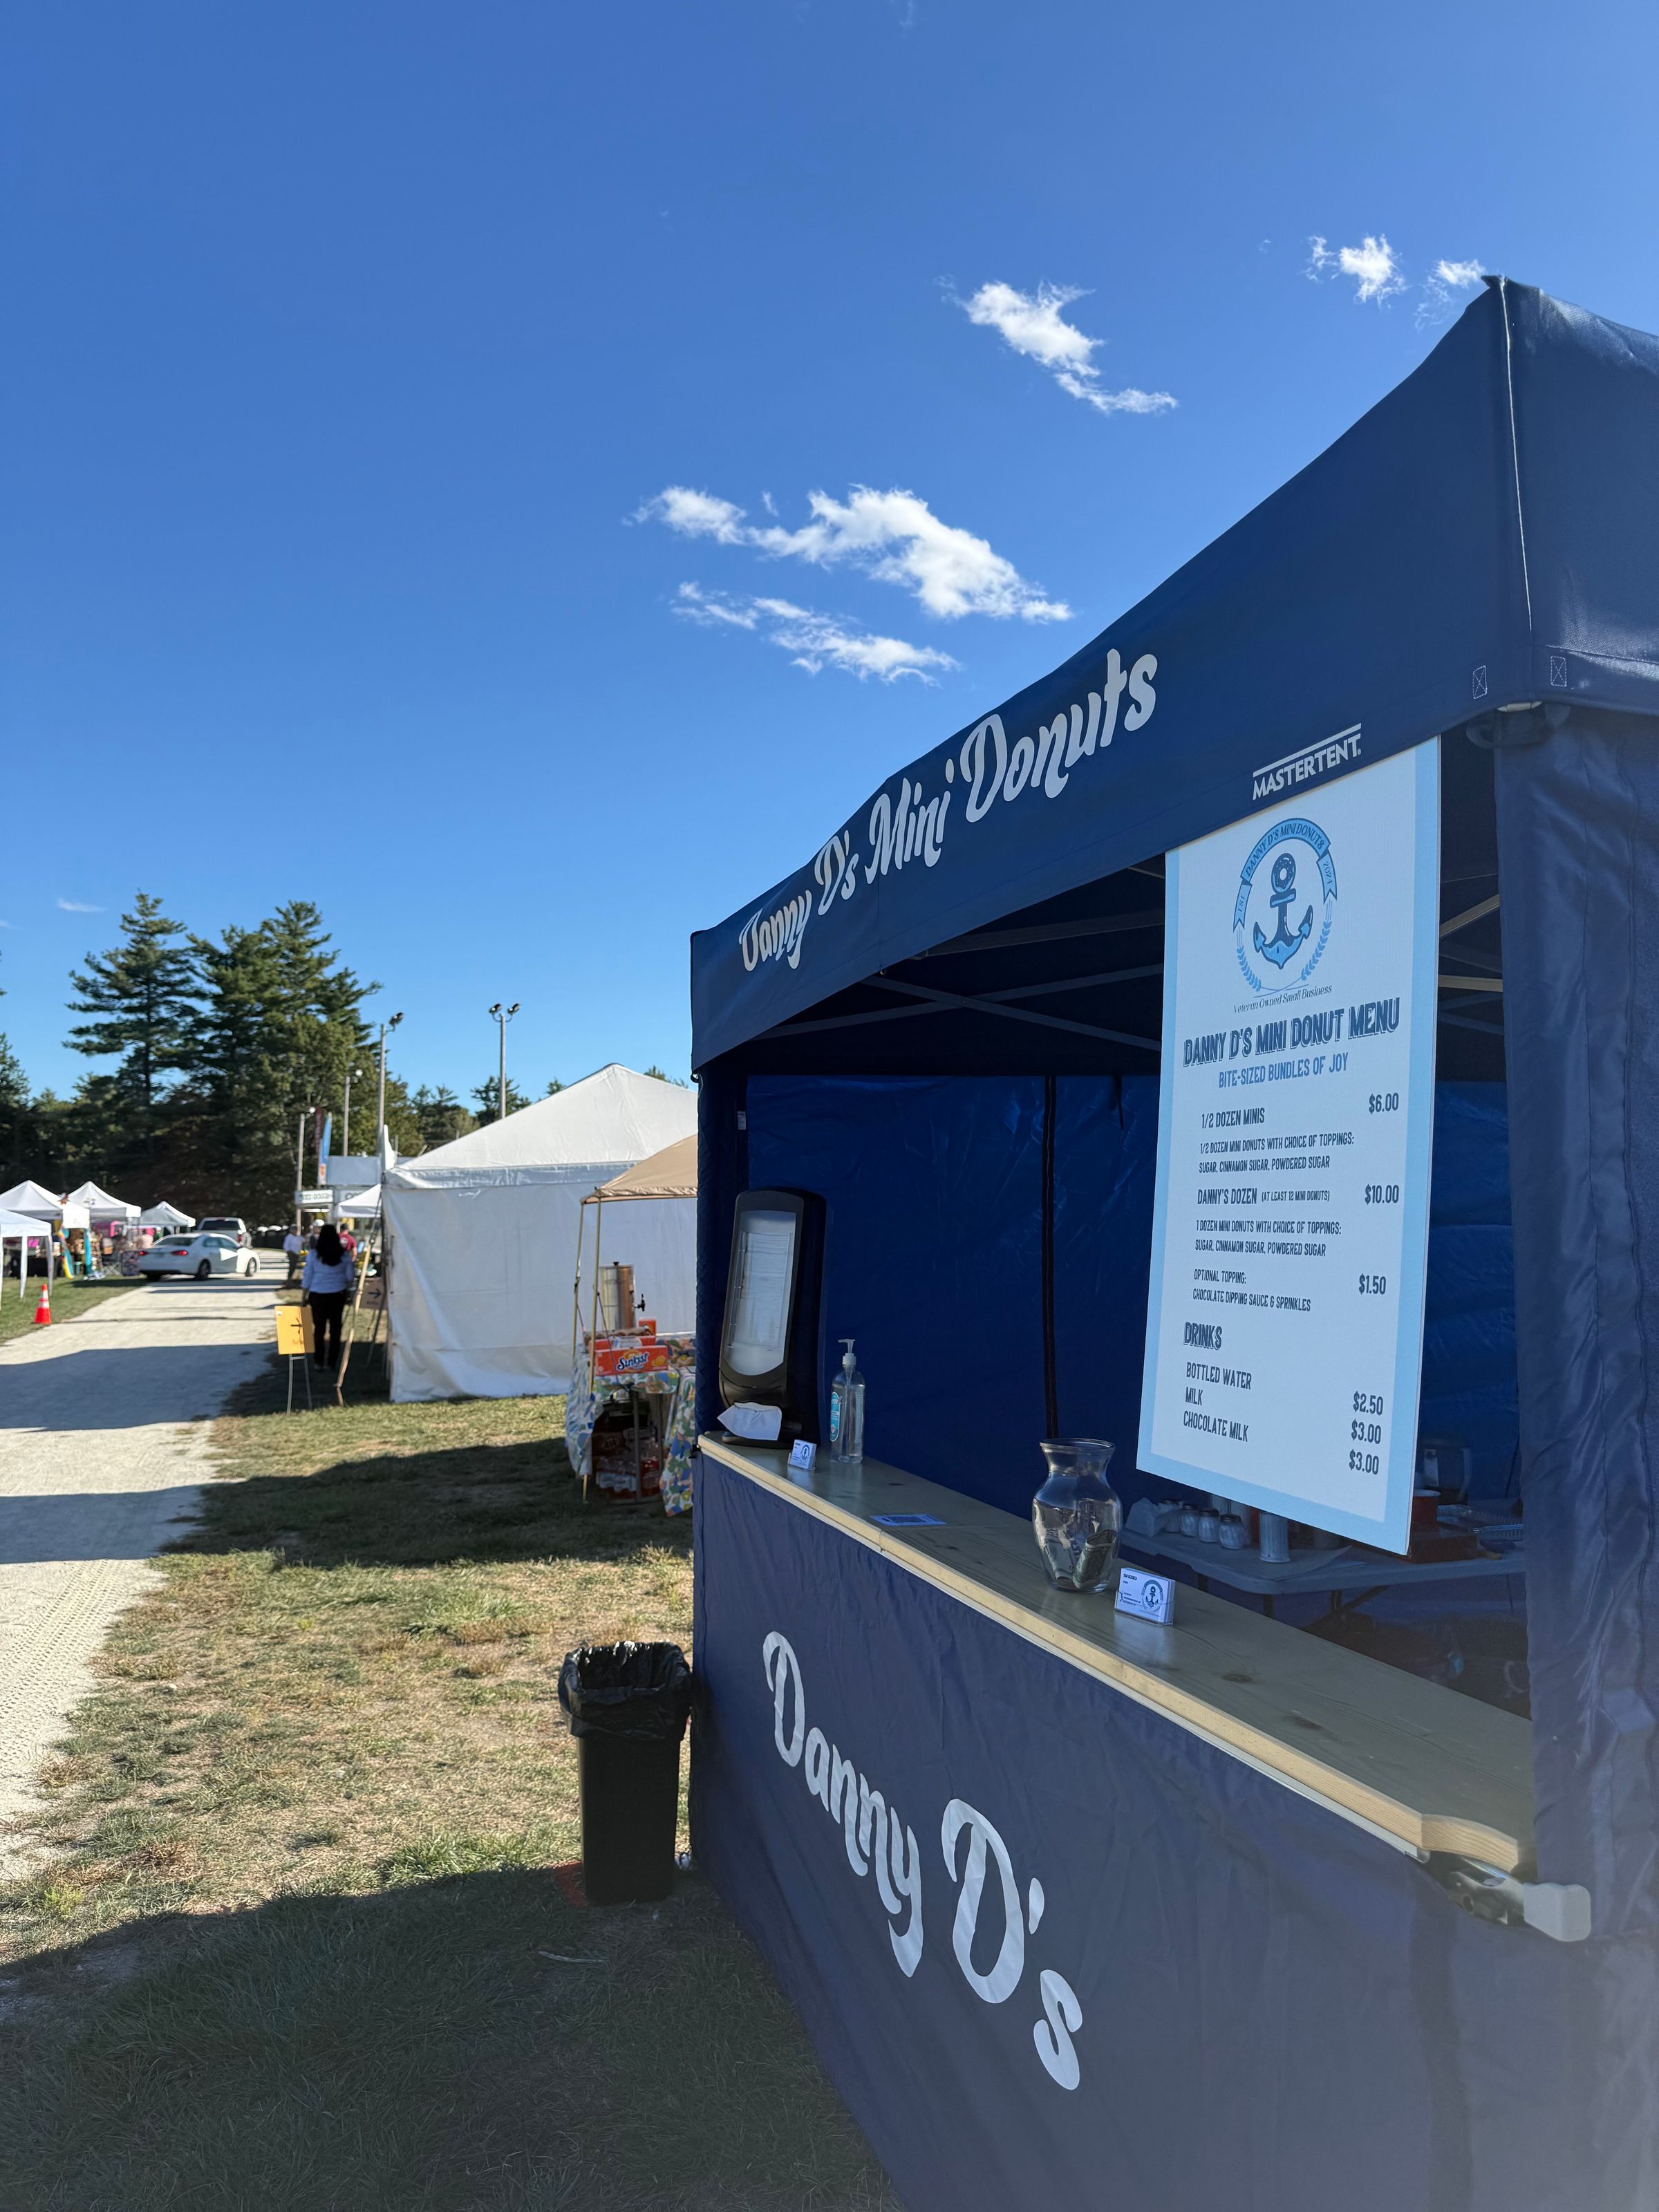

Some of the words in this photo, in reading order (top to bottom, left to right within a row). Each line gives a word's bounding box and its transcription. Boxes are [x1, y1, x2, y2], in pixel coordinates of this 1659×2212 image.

[1252, 733, 1362, 800] MASTERTENT
[814, 830, 859, 916] D's
[865, 758, 955, 885] Mini
[960, 648, 1159, 823] Donuts
[1245, 838, 1267, 878] DANNY
[1267, 830, 1279, 846] D'S
[1280, 823, 1297, 838] MINI
[1296, 823, 1326, 850] DONUTS
[1233, 1002, 1259, 1013] Veteran
[1259, 994, 1282, 1009] Owned
[1282, 989, 1302, 1003] Small
[1302, 984, 1333, 1000] Business
[1183, 1031, 1227, 1068] DANNY
[1228, 1027, 1253, 1060] D'S
[1255, 1020, 1287, 1056] MINI
[1290, 1008, 1344, 1049] DONUT
[1347, 997, 1400, 1040] MENU
[1219, 1065, 1266, 1089] BITE-SIZED
[1268, 1058, 1311, 1082] BUNDLES
[1313, 1056, 1327, 1076] OF
[1329, 1051, 1349, 1074] JOY
[1369, 1092, 1399, 1115] $6.00
[1201, 1112, 1214, 1129] 1/2
[1215, 1109, 1241, 1127] DOZEN
[1243, 1107, 1265, 1125] MINIS
[1200, 1141, 1210, 1154] 1/2
[1210, 1141, 1228, 1154] DOZEN
[1229, 1140, 1241, 1152] MINI
[1242, 1138, 1266, 1152] DONUTS
[1267, 1136, 1283, 1150] WITH
[1284, 1135, 1307, 1149] CHOICE
[1309, 1134, 1318, 1147] OF
[1319, 1132, 1355, 1147] TOPPINGS:
[1199, 1161, 1218, 1174] SUGAR,
[1219, 1159, 1248, 1172] CINNAMON
[1248, 1159, 1270, 1172] SUGAR,
[1271, 1156, 1307, 1171] POWDERED
[1308, 1155, 1331, 1170] SUGAR
[1197, 1188, 1229, 1205] DANNY'S
[1230, 1188, 1257, 1204] DOZEN
[1261, 1191, 1271, 1203] (AT
[1271, 1191, 1288, 1201] LEAST
[1288, 1191, 1294, 1201] 12
[1295, 1190, 1306, 1201] MINI
[1306, 1190, 1330, 1202] DONUTS)
[1365, 1183, 1400, 1205] $10.00
[1196, 1219, 1199, 1231] 1
[1199, 1219, 1218, 1232] DOZEN
[1219, 1220, 1230, 1232] MINI
[1231, 1220, 1255, 1232] DONUTS
[1255, 1221, 1272, 1233] WITH
[1273, 1221, 1295, 1234] CHOICE
[1296, 1221, 1306, 1234] OF
[1307, 1221, 1342, 1235] TOPPINGS:
[1195, 1239, 1215, 1252] SUGAR,
[1215, 1240, 1244, 1253] CINNAMON
[1245, 1241, 1266, 1255] SUGAR,
[1267, 1241, 1302, 1256] POWDERED
[1304, 1243, 1327, 1257] SUGAR
[1194, 1268, 1219, 1282] OPTIONAL
[1221, 1271, 1247, 1284] TOPPING:
[1358, 1273, 1387, 1295] $1.50
[1192, 1288, 1224, 1303] CHOCOLATE
[1225, 1291, 1248, 1306] DIPPING
[1248, 1293, 1268, 1307] SAUCE
[1270, 1295, 1275, 1308] &
[1276, 1296, 1311, 1312] SPRINKLES
[1183, 1322, 1223, 1351] DRINKS
[617, 1351, 650, 1371] Sunkist
[1186, 1362, 1221, 1384] BOTTLED
[1222, 1368, 1252, 1390] WATER
[1185, 1387, 1203, 1406] MILK
[1353, 1391, 1384, 1416] $2.50
[1183, 1410, 1228, 1436] CHOCOLATE
[1229, 1421, 1249, 1442] MILK
[1351, 1418, 1382, 1445] $3.00
[1349, 1448, 1380, 1475] $3.00
[762, 1631, 924, 1978] Danny
[941, 1798, 1083, 2091] D's
